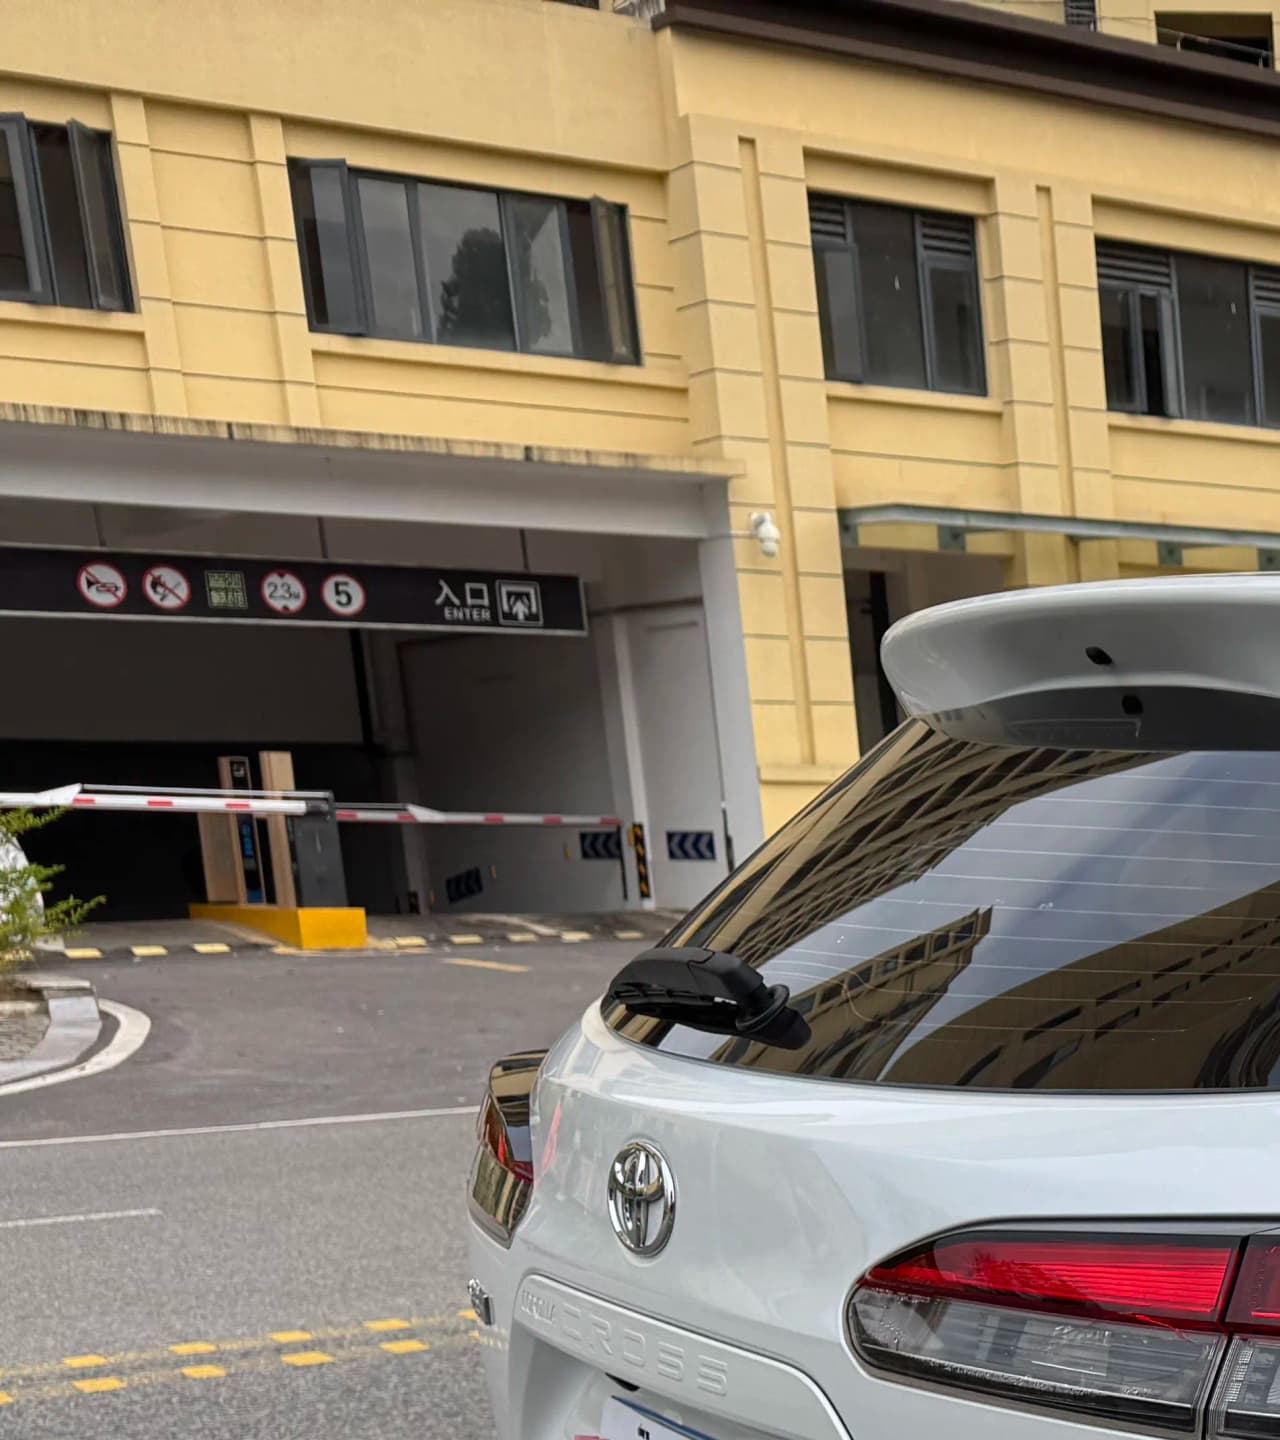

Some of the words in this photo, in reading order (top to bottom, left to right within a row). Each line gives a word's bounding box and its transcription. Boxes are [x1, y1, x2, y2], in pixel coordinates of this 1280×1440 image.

[334, 581, 352, 607] 5
[435, 579, 490, 607] 入口
[444, 606, 491, 621] ENTER
[560, 1302, 729, 1397] CROSS
